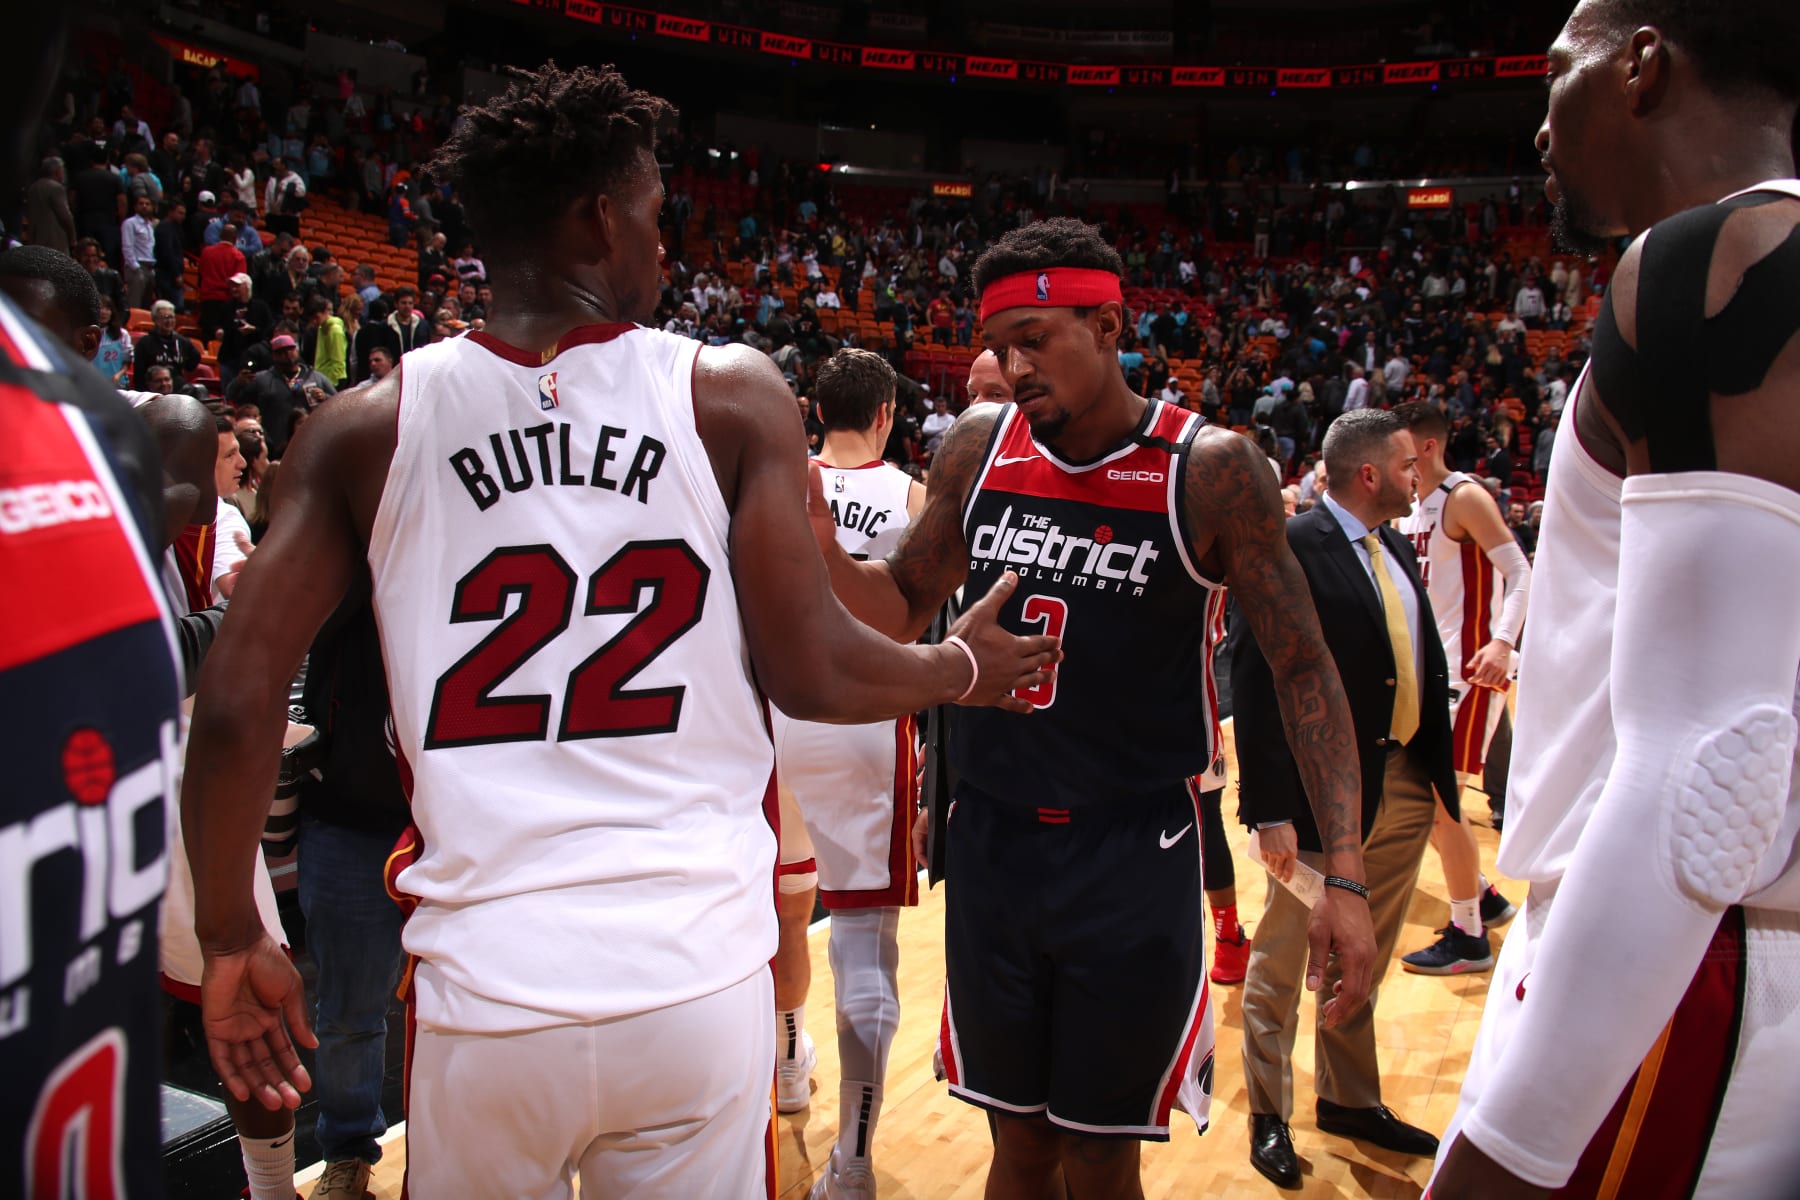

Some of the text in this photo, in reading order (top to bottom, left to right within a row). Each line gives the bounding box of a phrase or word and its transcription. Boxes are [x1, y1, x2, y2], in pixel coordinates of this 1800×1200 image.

[567, 1, 600, 18] HEAT
[610, 10, 648, 30] WIN
[659, 19, 706, 38] HEAT
[717, 29, 753, 47] WIN
[764, 35, 808, 53] HEAT
[818, 44, 853, 64] WIN
[864, 51, 911, 66] HEAT
[921, 55, 958, 73] WIN
[968, 60, 1012, 74] HEAT
[1026, 64, 1060, 81] WIN
[1072, 67, 1115, 82] HEAT
[1128, 69, 1165, 84] WIN
[1175, 71, 1219, 83] HEAT
[1232, 71, 1269, 86] WIN
[1281, 72, 1325, 85] HEAT
[1338, 67, 1375, 85] WIN
[1388, 66, 1432, 80] HEAT
[1447, 62, 1487, 79] WIN
[1500, 60, 1545, 73] HEAT
[449, 422, 667, 512] BUTLER
[1107, 469, 1164, 483] GEICO
[0, 480, 112, 535] GEICO
[1022, 513, 1052, 530] THE
[970, 560, 990, 572] OF
[971, 504, 1160, 584] district
[423, 538, 711, 751] 22
